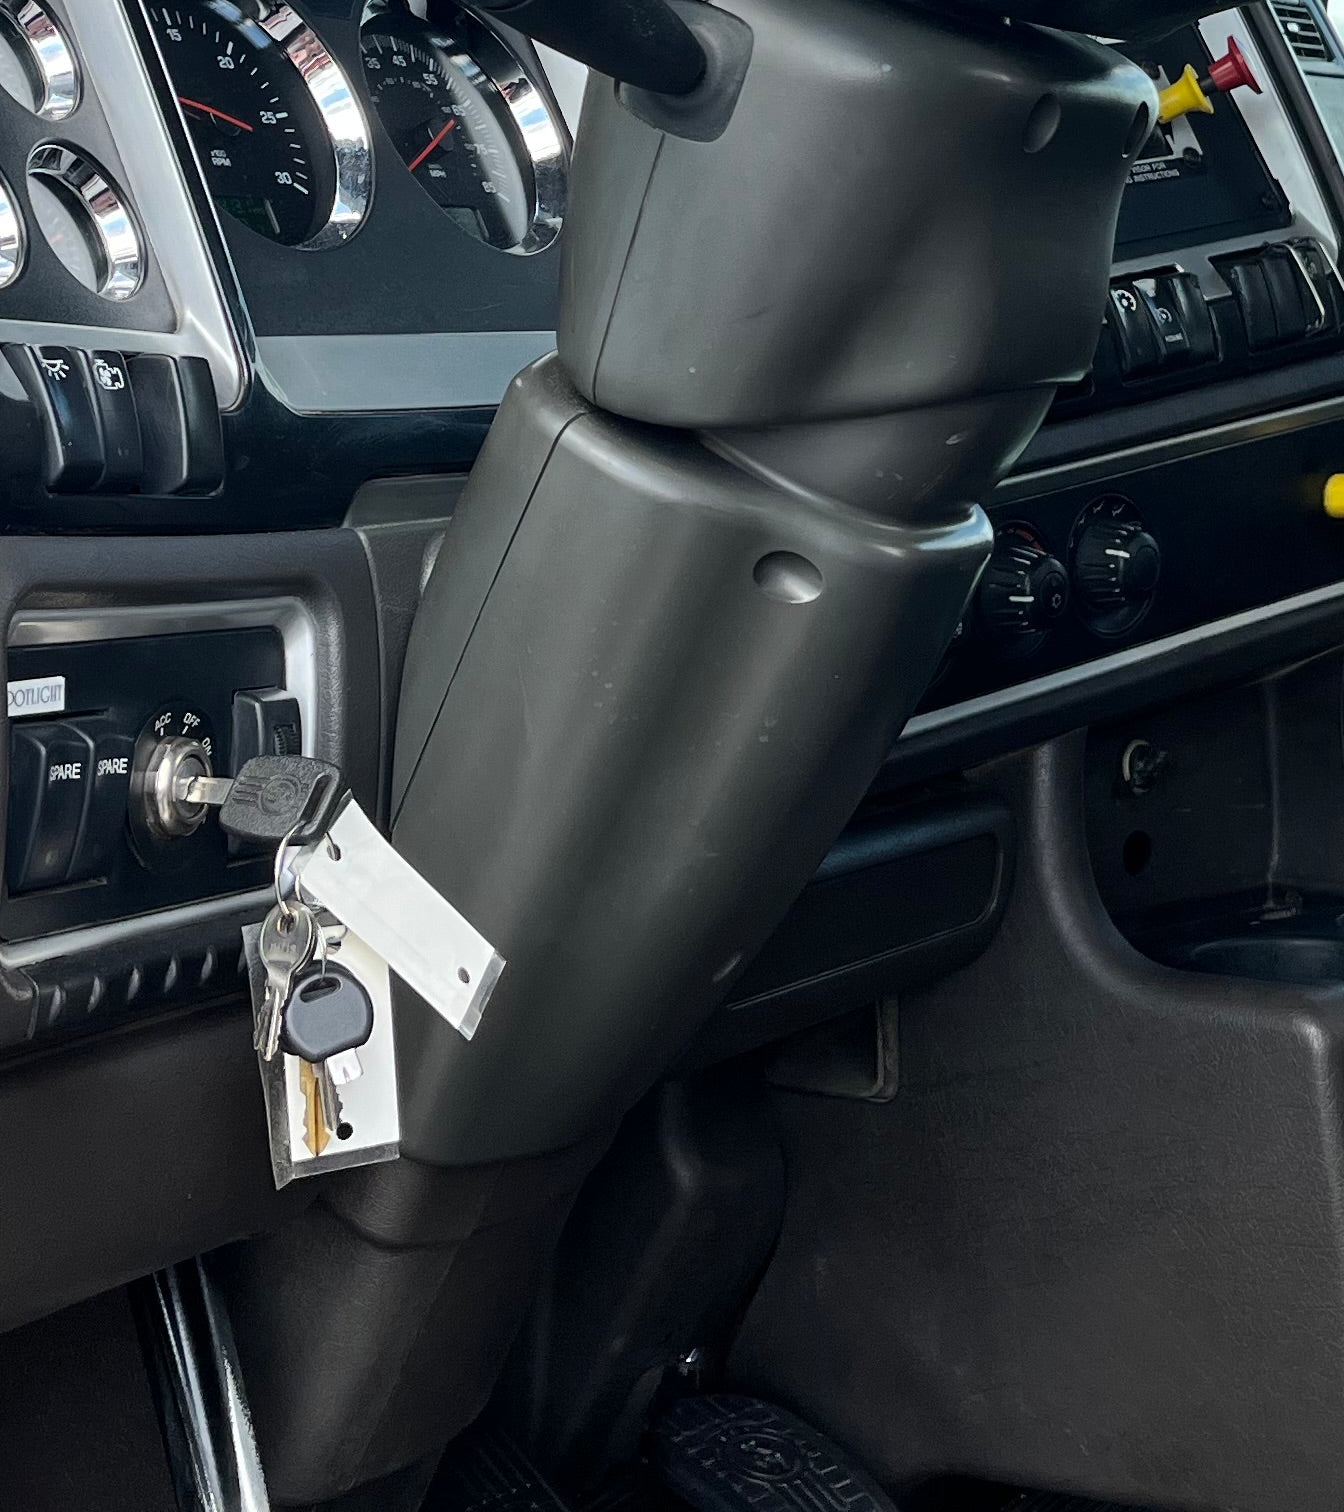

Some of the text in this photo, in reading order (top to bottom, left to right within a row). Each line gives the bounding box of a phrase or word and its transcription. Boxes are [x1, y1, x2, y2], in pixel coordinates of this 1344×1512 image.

[166, 29, 182, 42] 15
[217, 55, 235, 70] 20
[392, 54, 407, 68] 45
[422, 73, 439, 86] 55
[452, 103, 467, 117] 65
[260, 111, 277, 125] 25
[211, 157, 232, 167] RPM
[275, 171, 293, 185] 30
[1134, 169, 1180, 183] INSTRUCTIONS
[154, 712, 172, 732] ACC
[183, 712, 201, 728] OFF
[49, 763, 81, 782] SPARE
[97, 758, 128, 776] SPARE
